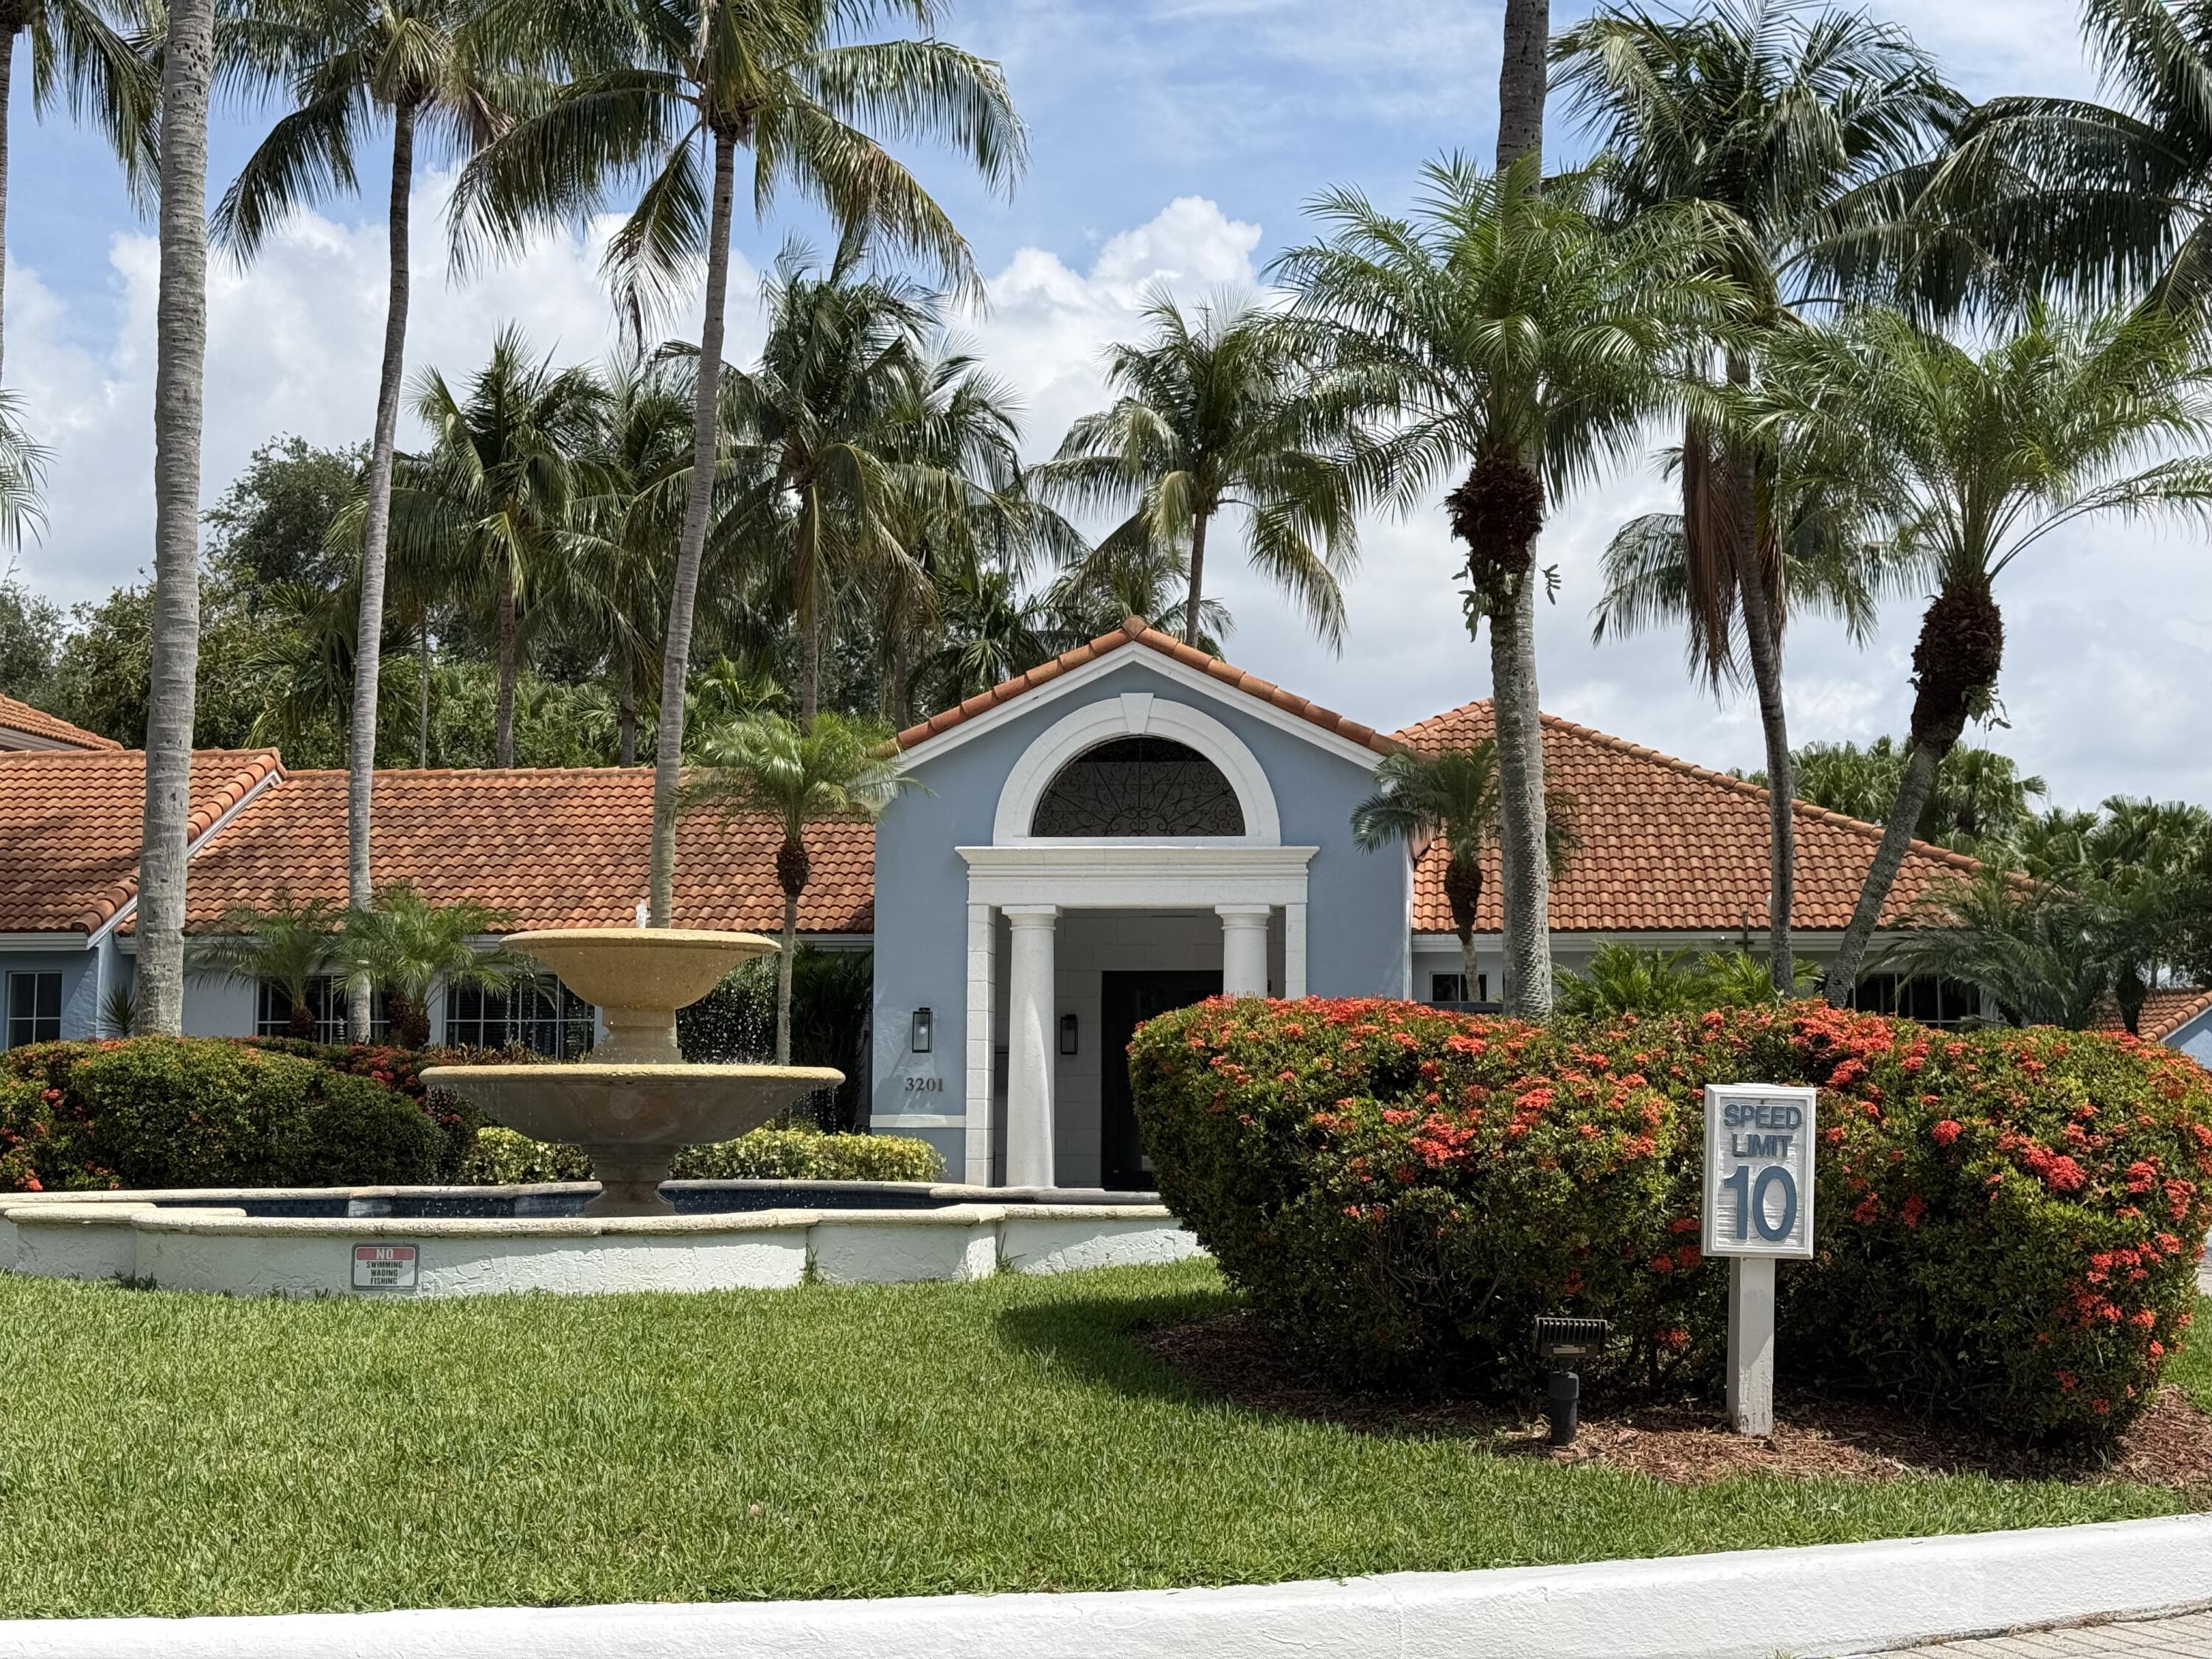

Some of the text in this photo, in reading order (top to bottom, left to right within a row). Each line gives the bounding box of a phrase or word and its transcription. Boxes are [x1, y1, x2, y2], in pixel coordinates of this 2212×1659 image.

[905, 1077, 943, 1091] 3201
[1723, 1104, 1802, 1130] SPEED
[1733, 1133, 1793, 1158] LIMIT
[1724, 1165, 1798, 1242] 10
[376, 1248, 394, 1259] NO
